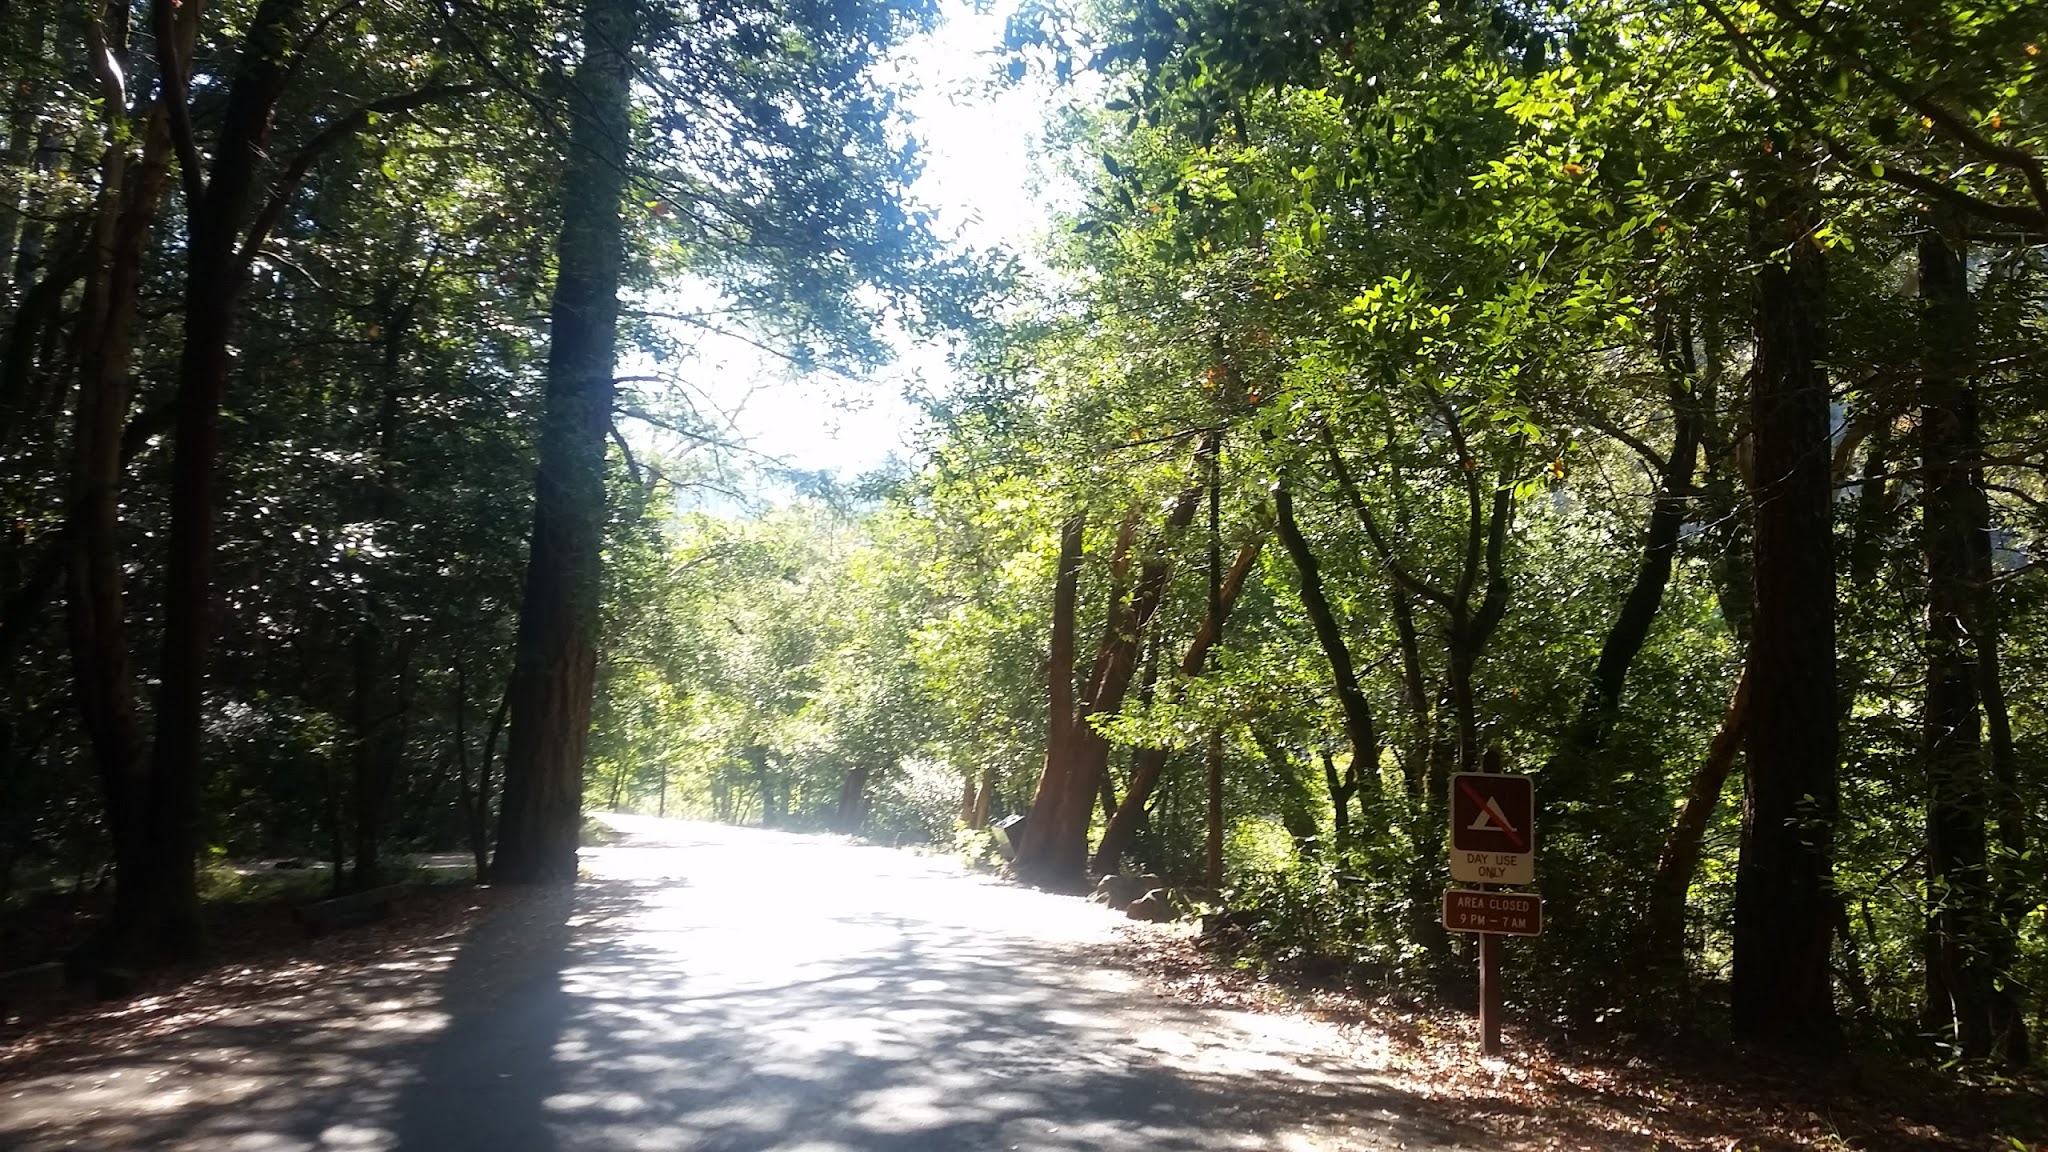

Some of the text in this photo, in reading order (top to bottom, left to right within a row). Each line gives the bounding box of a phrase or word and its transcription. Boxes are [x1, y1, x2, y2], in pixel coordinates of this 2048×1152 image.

[1467, 853, 1517, 866] DAY USE
[1478, 866, 1506, 878] ONLY
[1457, 897, 1529, 912] AREA CLOSED
[1460, 914, 1467, 924] 9
[1470, 914, 1486, 926] PM
[1502, 917, 1509, 927] 7
[1511, 918, 1526, 928] AM
